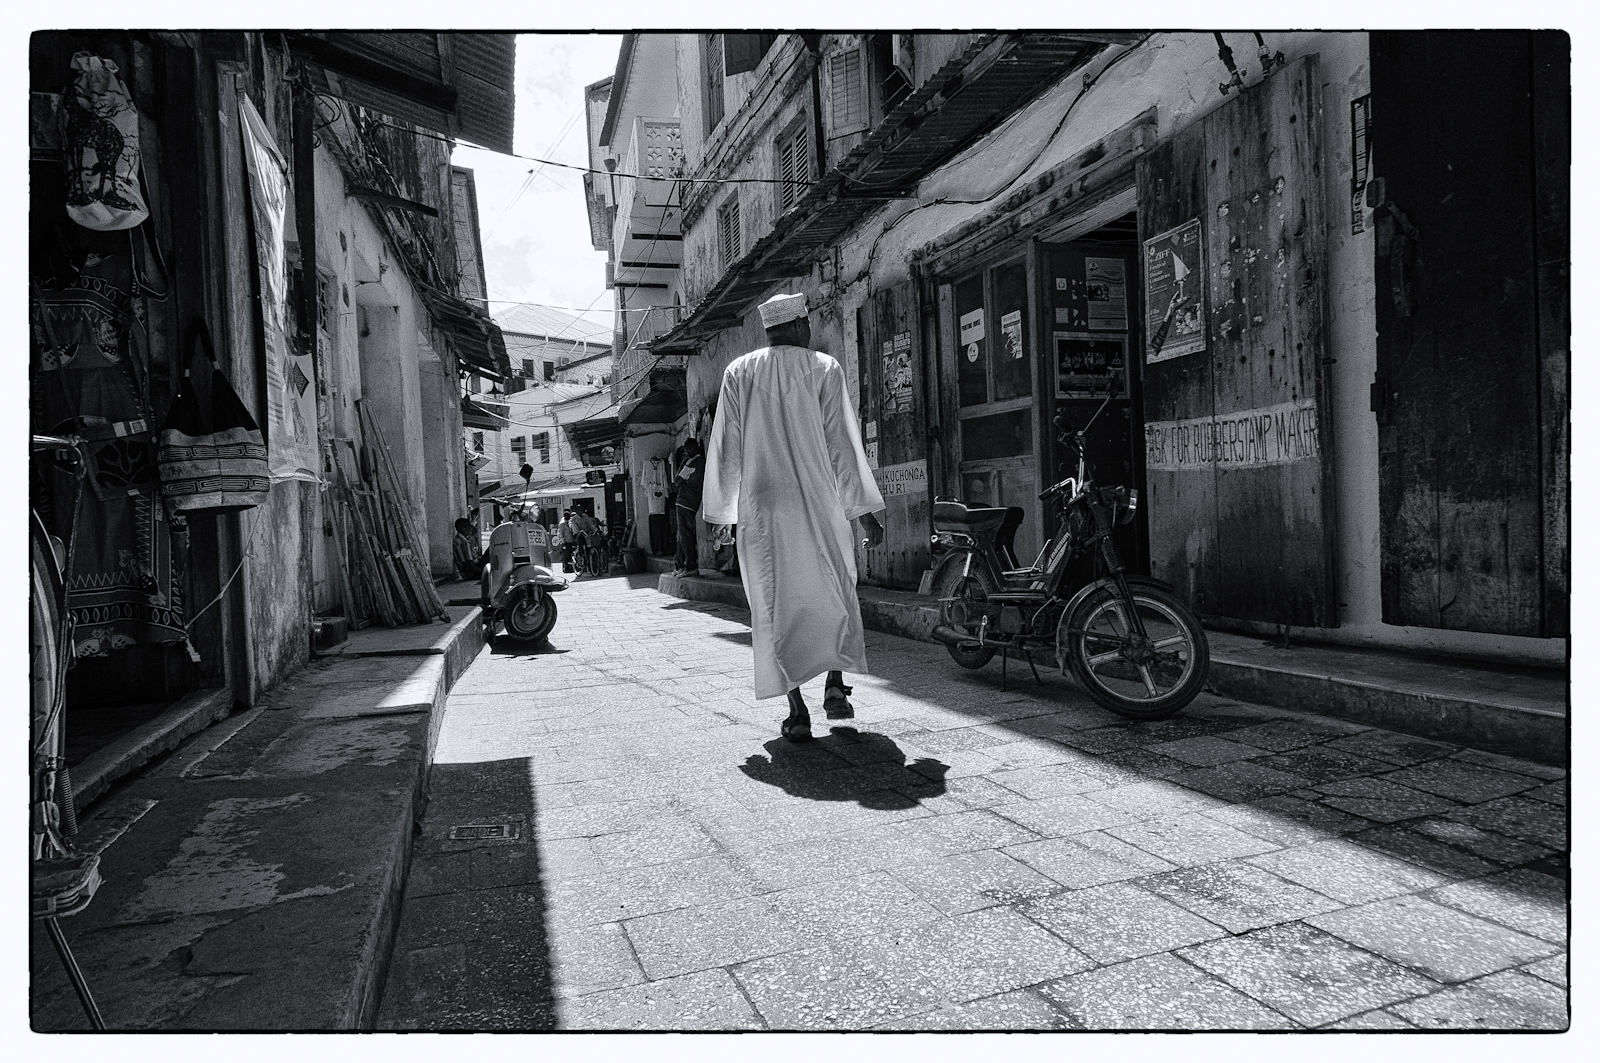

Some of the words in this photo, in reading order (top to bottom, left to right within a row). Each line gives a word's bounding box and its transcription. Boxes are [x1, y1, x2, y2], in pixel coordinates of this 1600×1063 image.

[1147, 426, 1168, 464] ASK
[1171, 425, 1190, 464] FOR
[1275, 406, 1318, 460] MAKER
[884, 467, 926, 483] KUCHONGA
[880, 483, 906, 494] HURI
